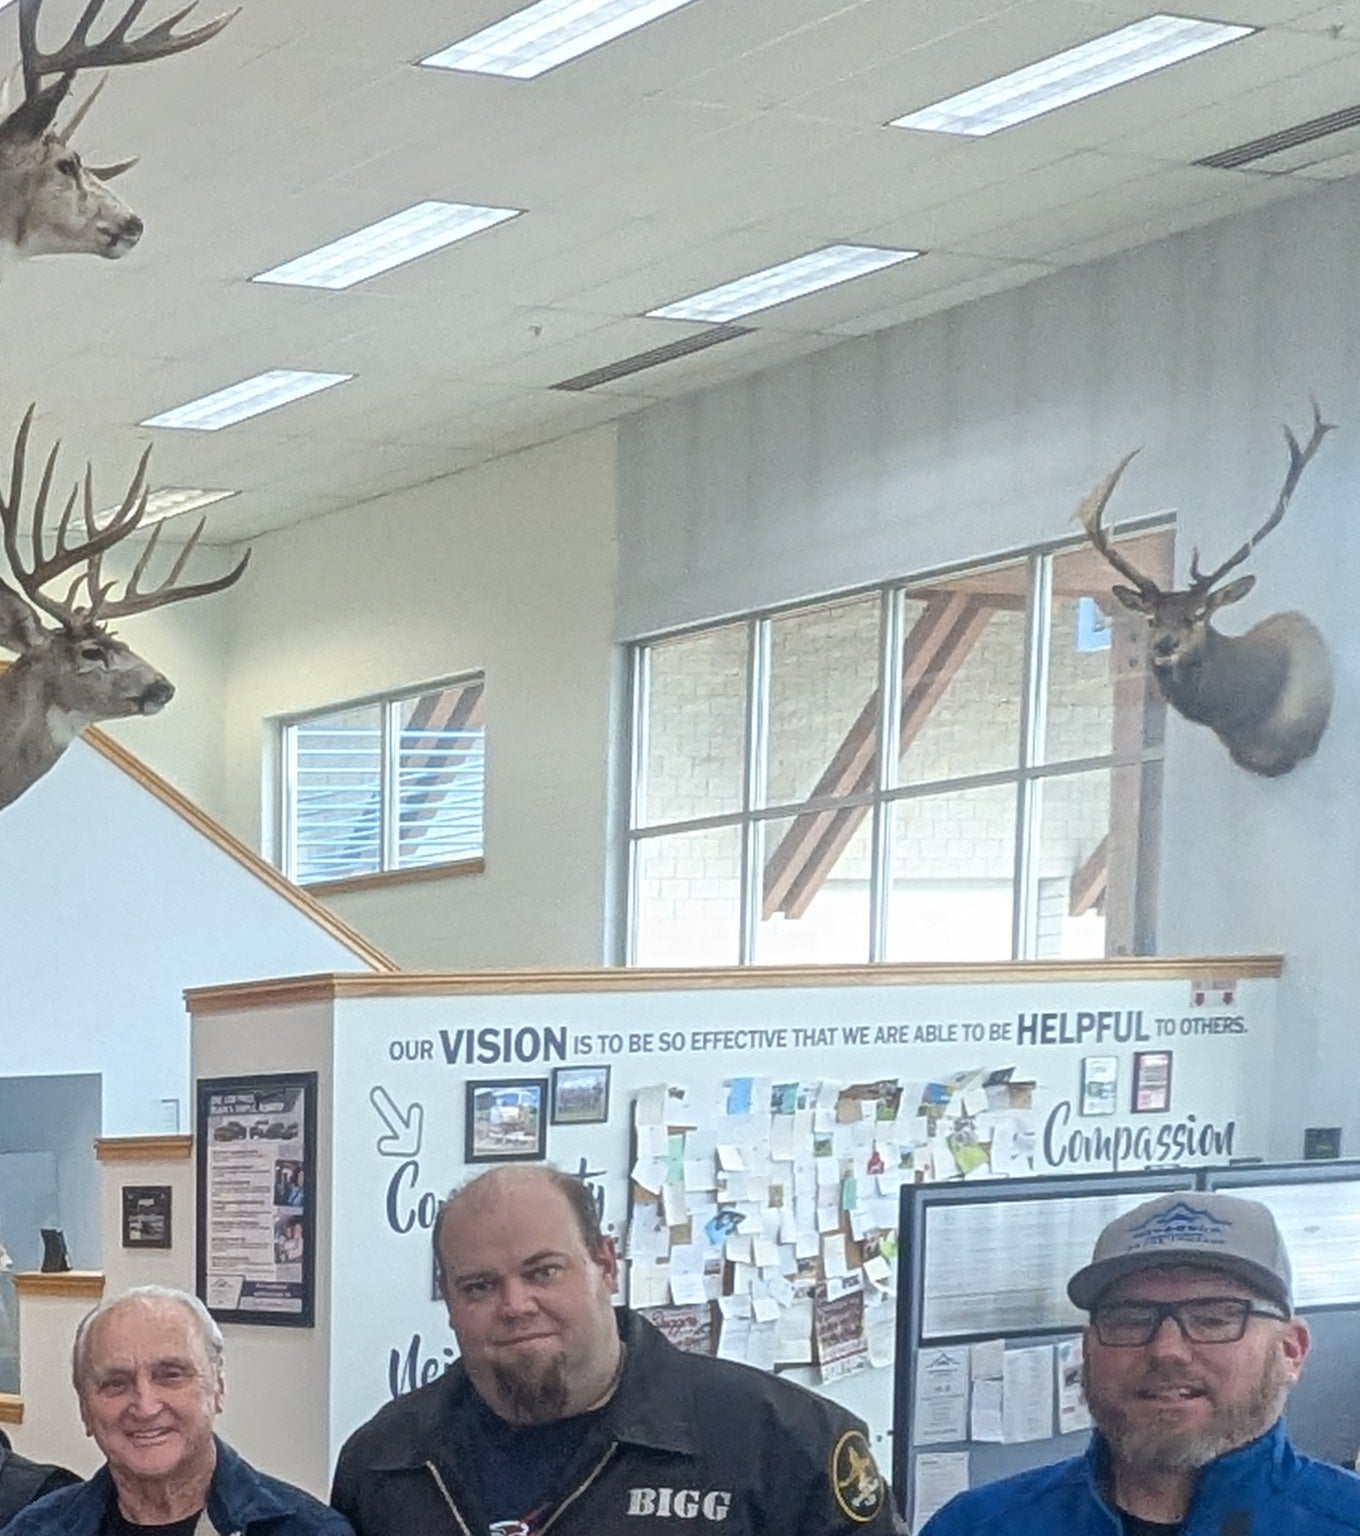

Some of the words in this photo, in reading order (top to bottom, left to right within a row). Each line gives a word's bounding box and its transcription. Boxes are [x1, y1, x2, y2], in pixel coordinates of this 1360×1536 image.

[388, 1039, 434, 1061] OUR
[438, 1026, 568, 1065] VISION
[573, 1035, 593, 1056] IS
[597, 1034, 624, 1055] TO
[628, 1033, 654, 1054] BE
[658, 1031, 686, 1052] SO
[690, 1027, 788, 1050] EFFECTIVE
[791, 1026, 839, 1048] THAT
[842, 1025, 871, 1046] WE
[874, 1024, 909, 1045] ARE
[913, 1022, 958, 1043] ABLE
[961, 1021, 983, 1042] TO
[988, 1020, 1012, 1041] BE
[1016, 1010, 1150, 1046] HELPFUL
[1154, 1016, 1176, 1036] TO
[1179, 1015, 1249, 1035] OTHERS.
[1043, 1100, 1235, 1171] Compassion
[626, 1487, 732, 1522] BIGG
